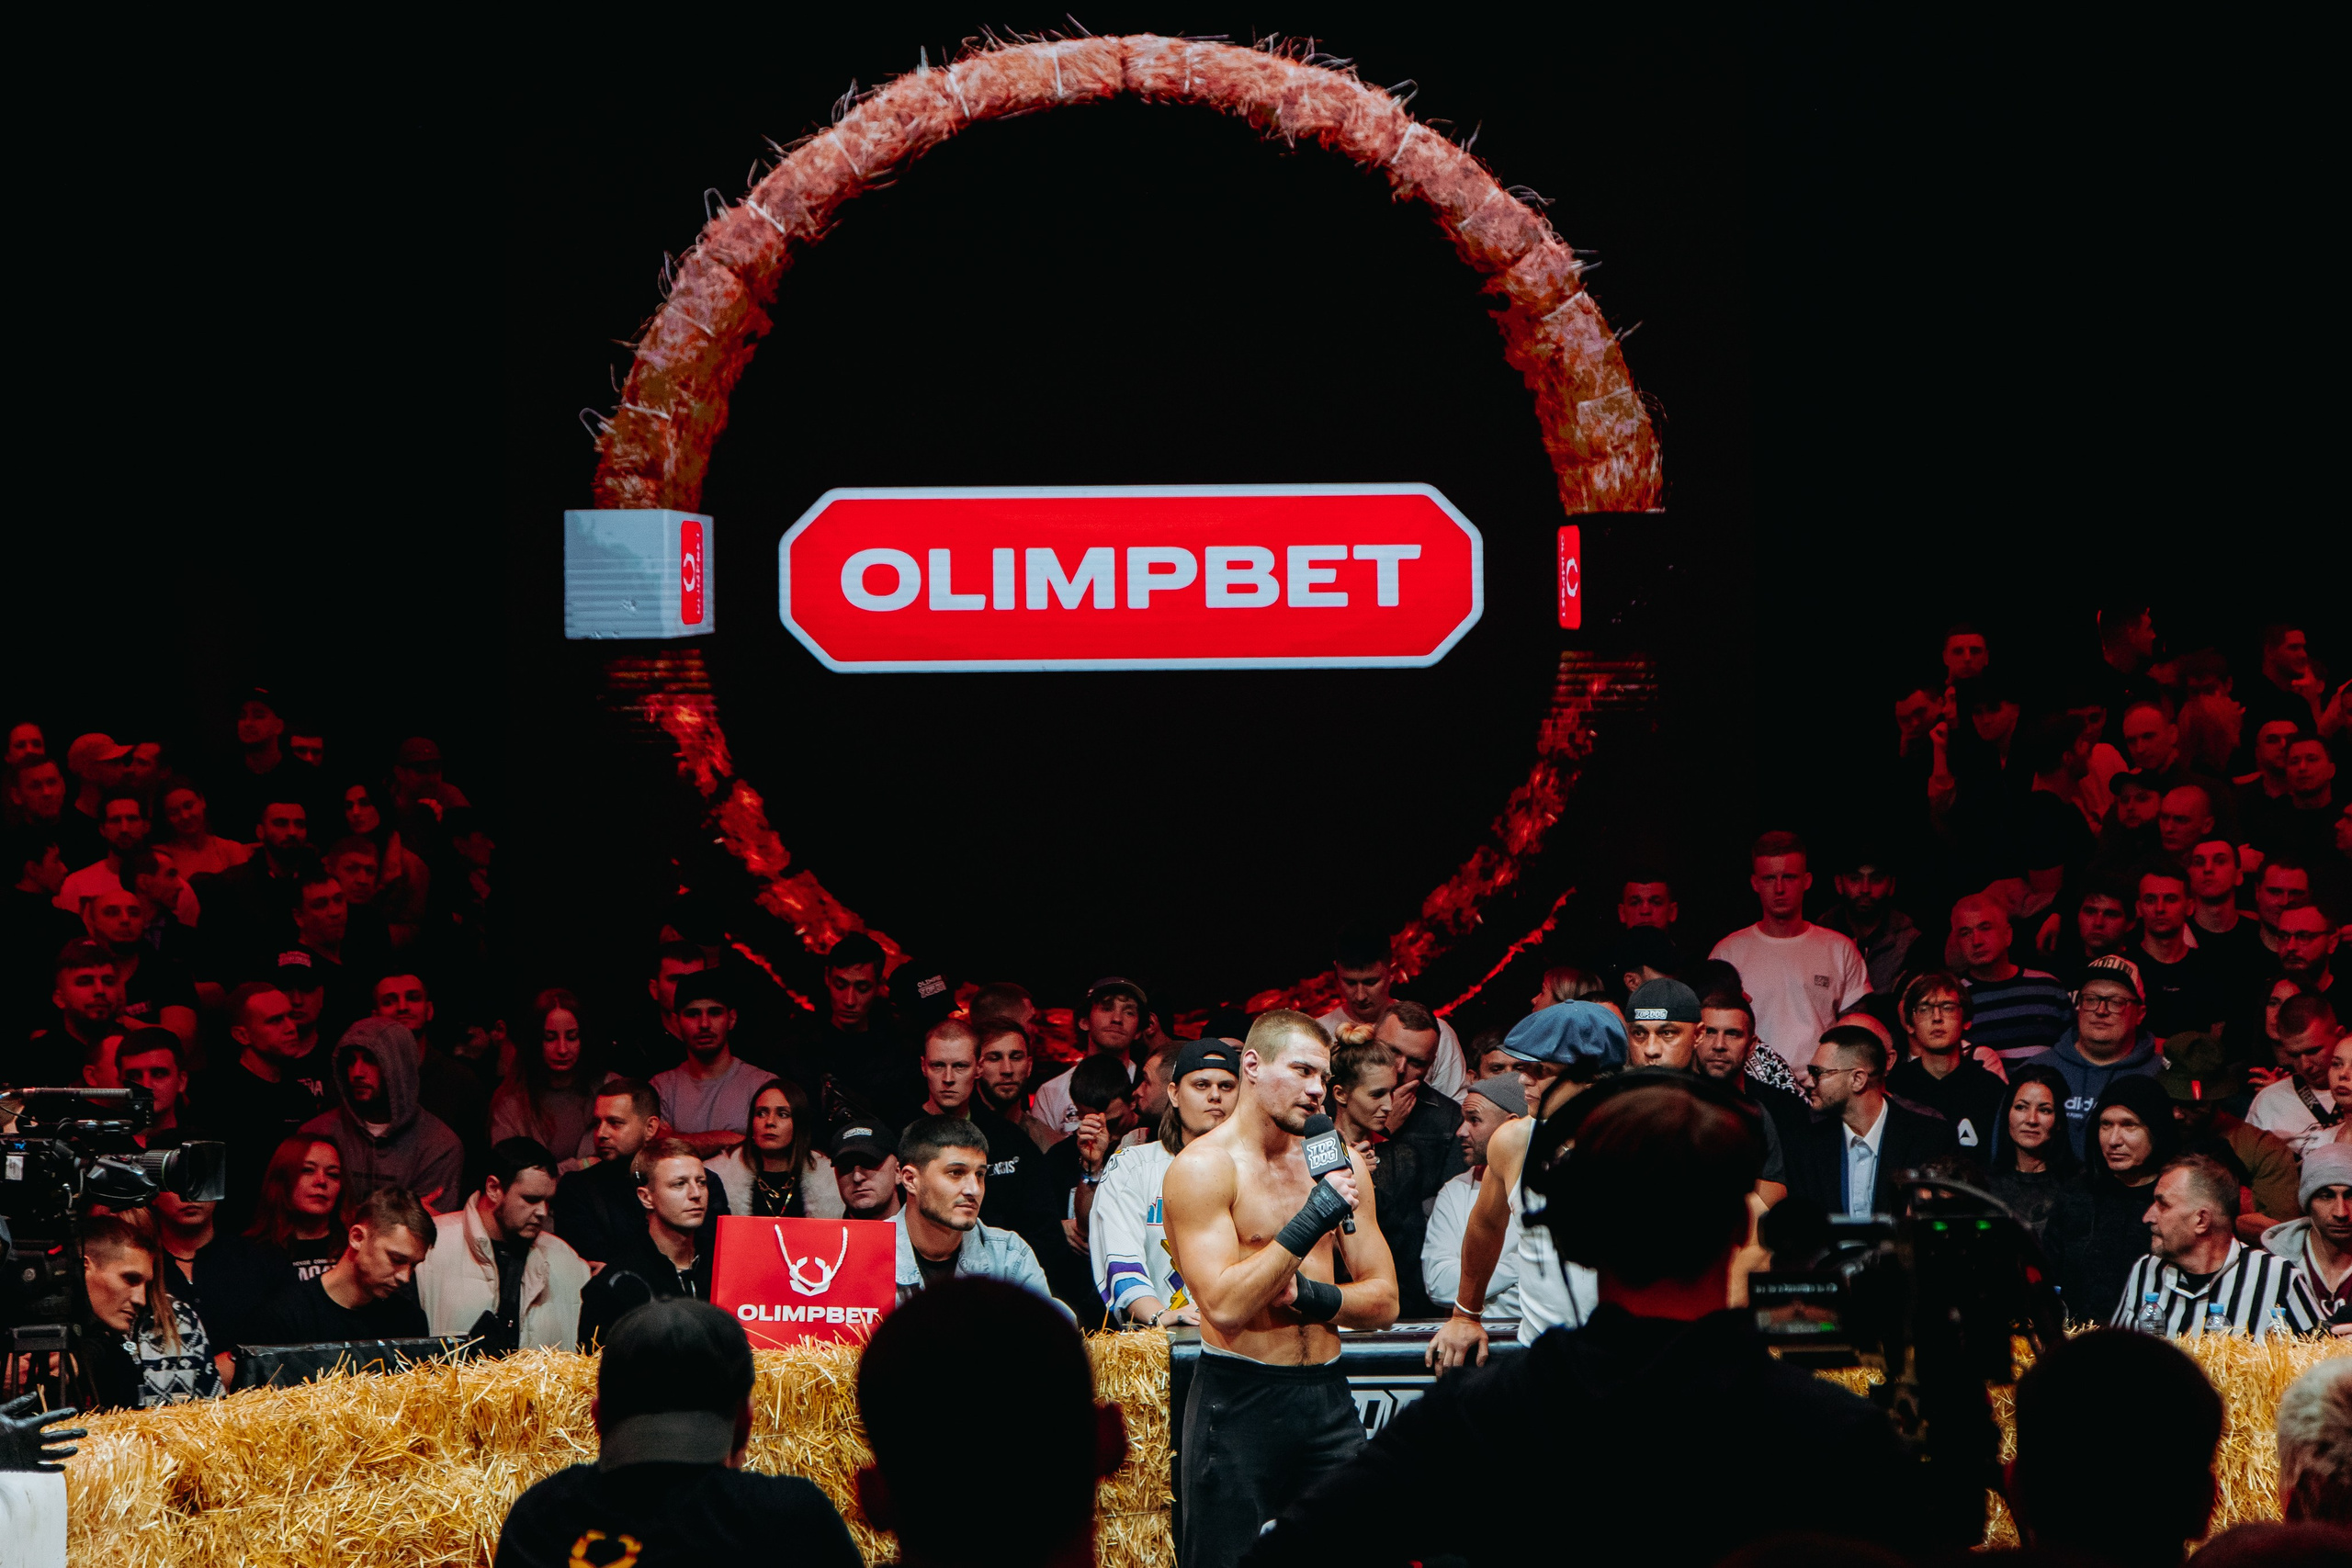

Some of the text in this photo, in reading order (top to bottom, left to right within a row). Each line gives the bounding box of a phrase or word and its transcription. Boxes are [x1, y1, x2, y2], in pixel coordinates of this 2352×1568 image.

[840, 544, 1422, 612] OLIMPBET
[1309, 1139, 1334, 1156] TOP
[1311, 1149, 1336, 1166] DOG
[737, 1303, 879, 1324] OLIMPBET
